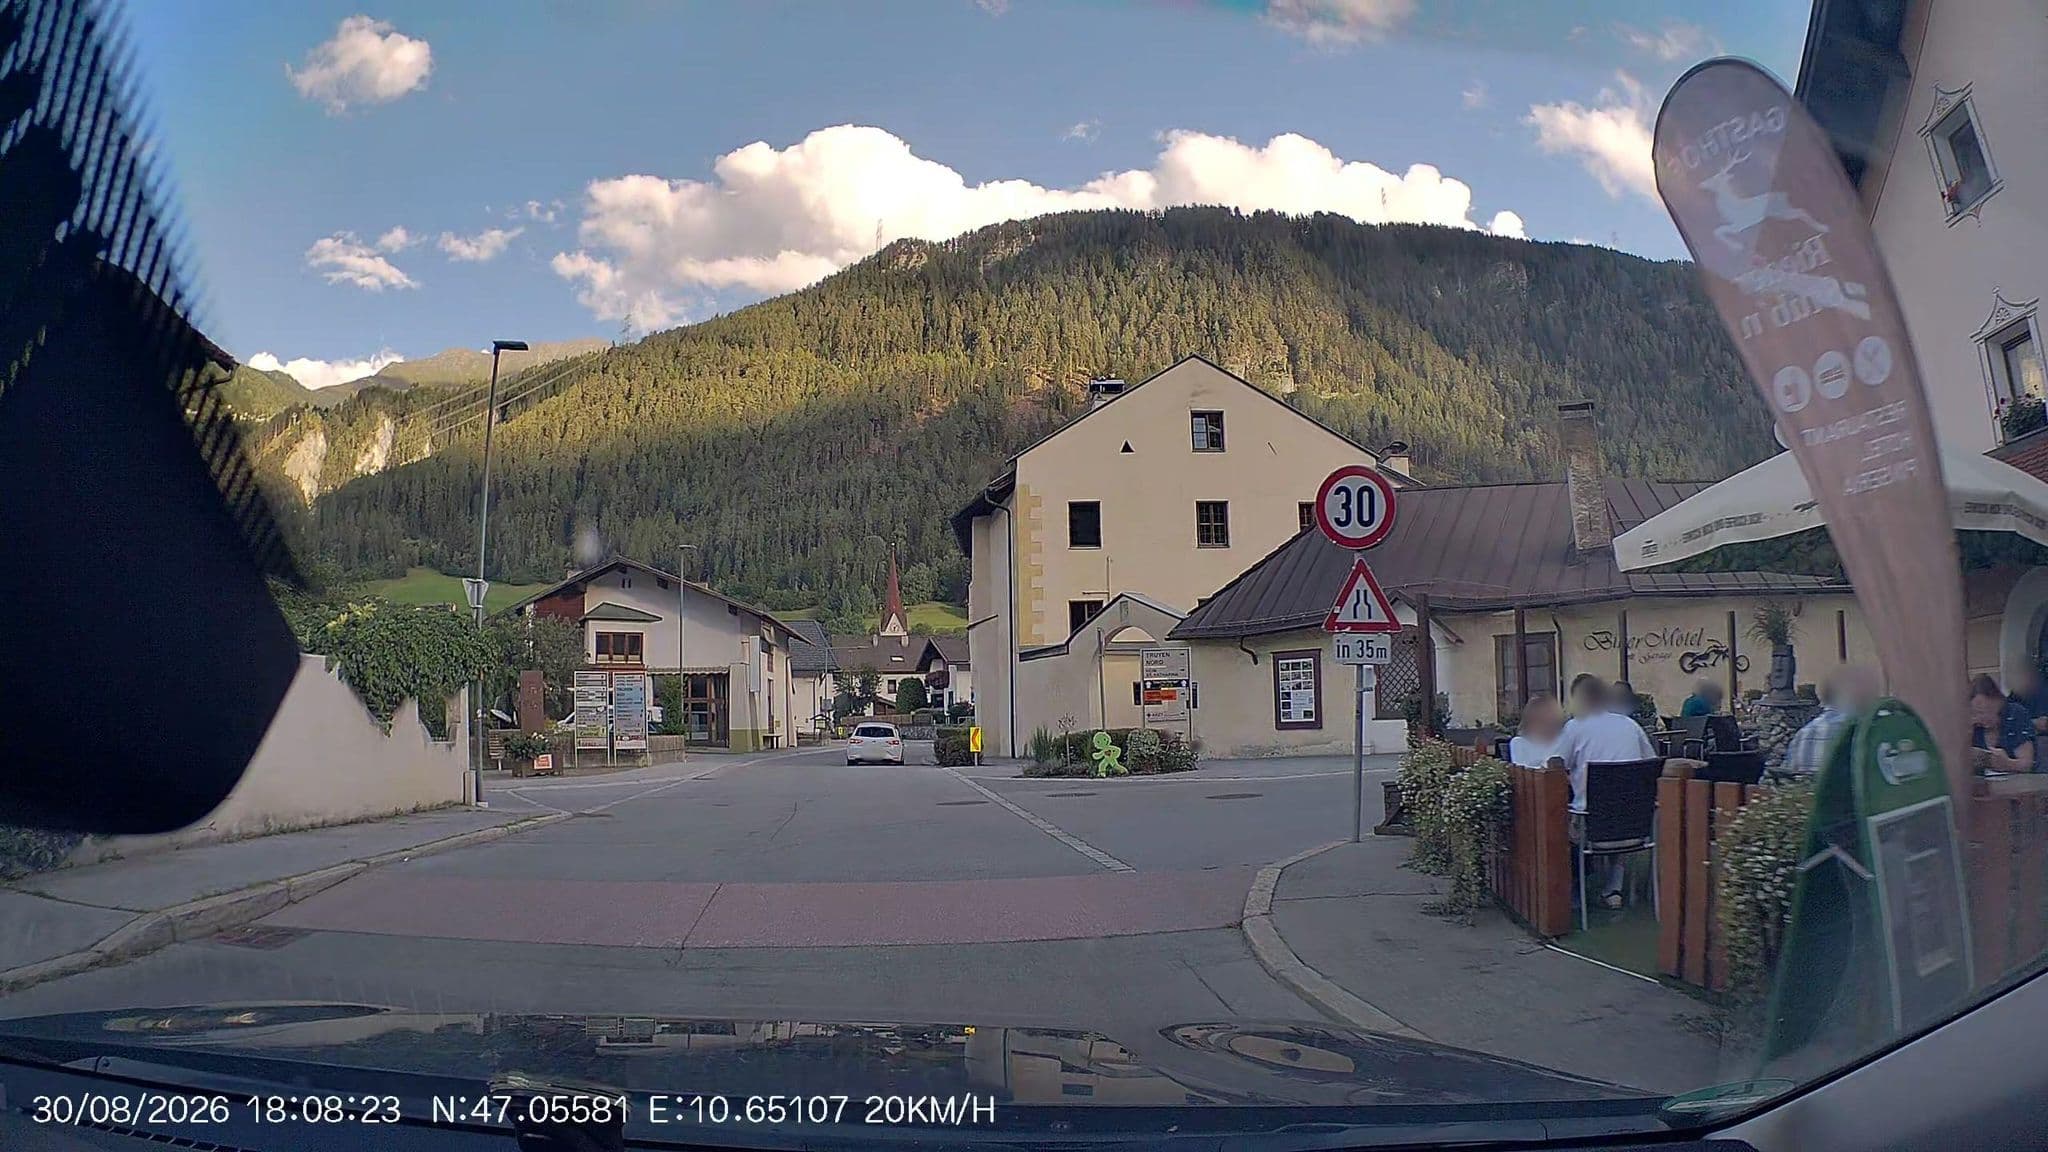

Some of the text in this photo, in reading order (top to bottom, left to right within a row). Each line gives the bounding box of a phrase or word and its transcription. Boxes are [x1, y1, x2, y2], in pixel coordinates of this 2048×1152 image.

[1333, 485, 1376, 528] 30
[1336, 639, 1350, 658] in
[1583, 627, 1705, 650] Bier Motel
